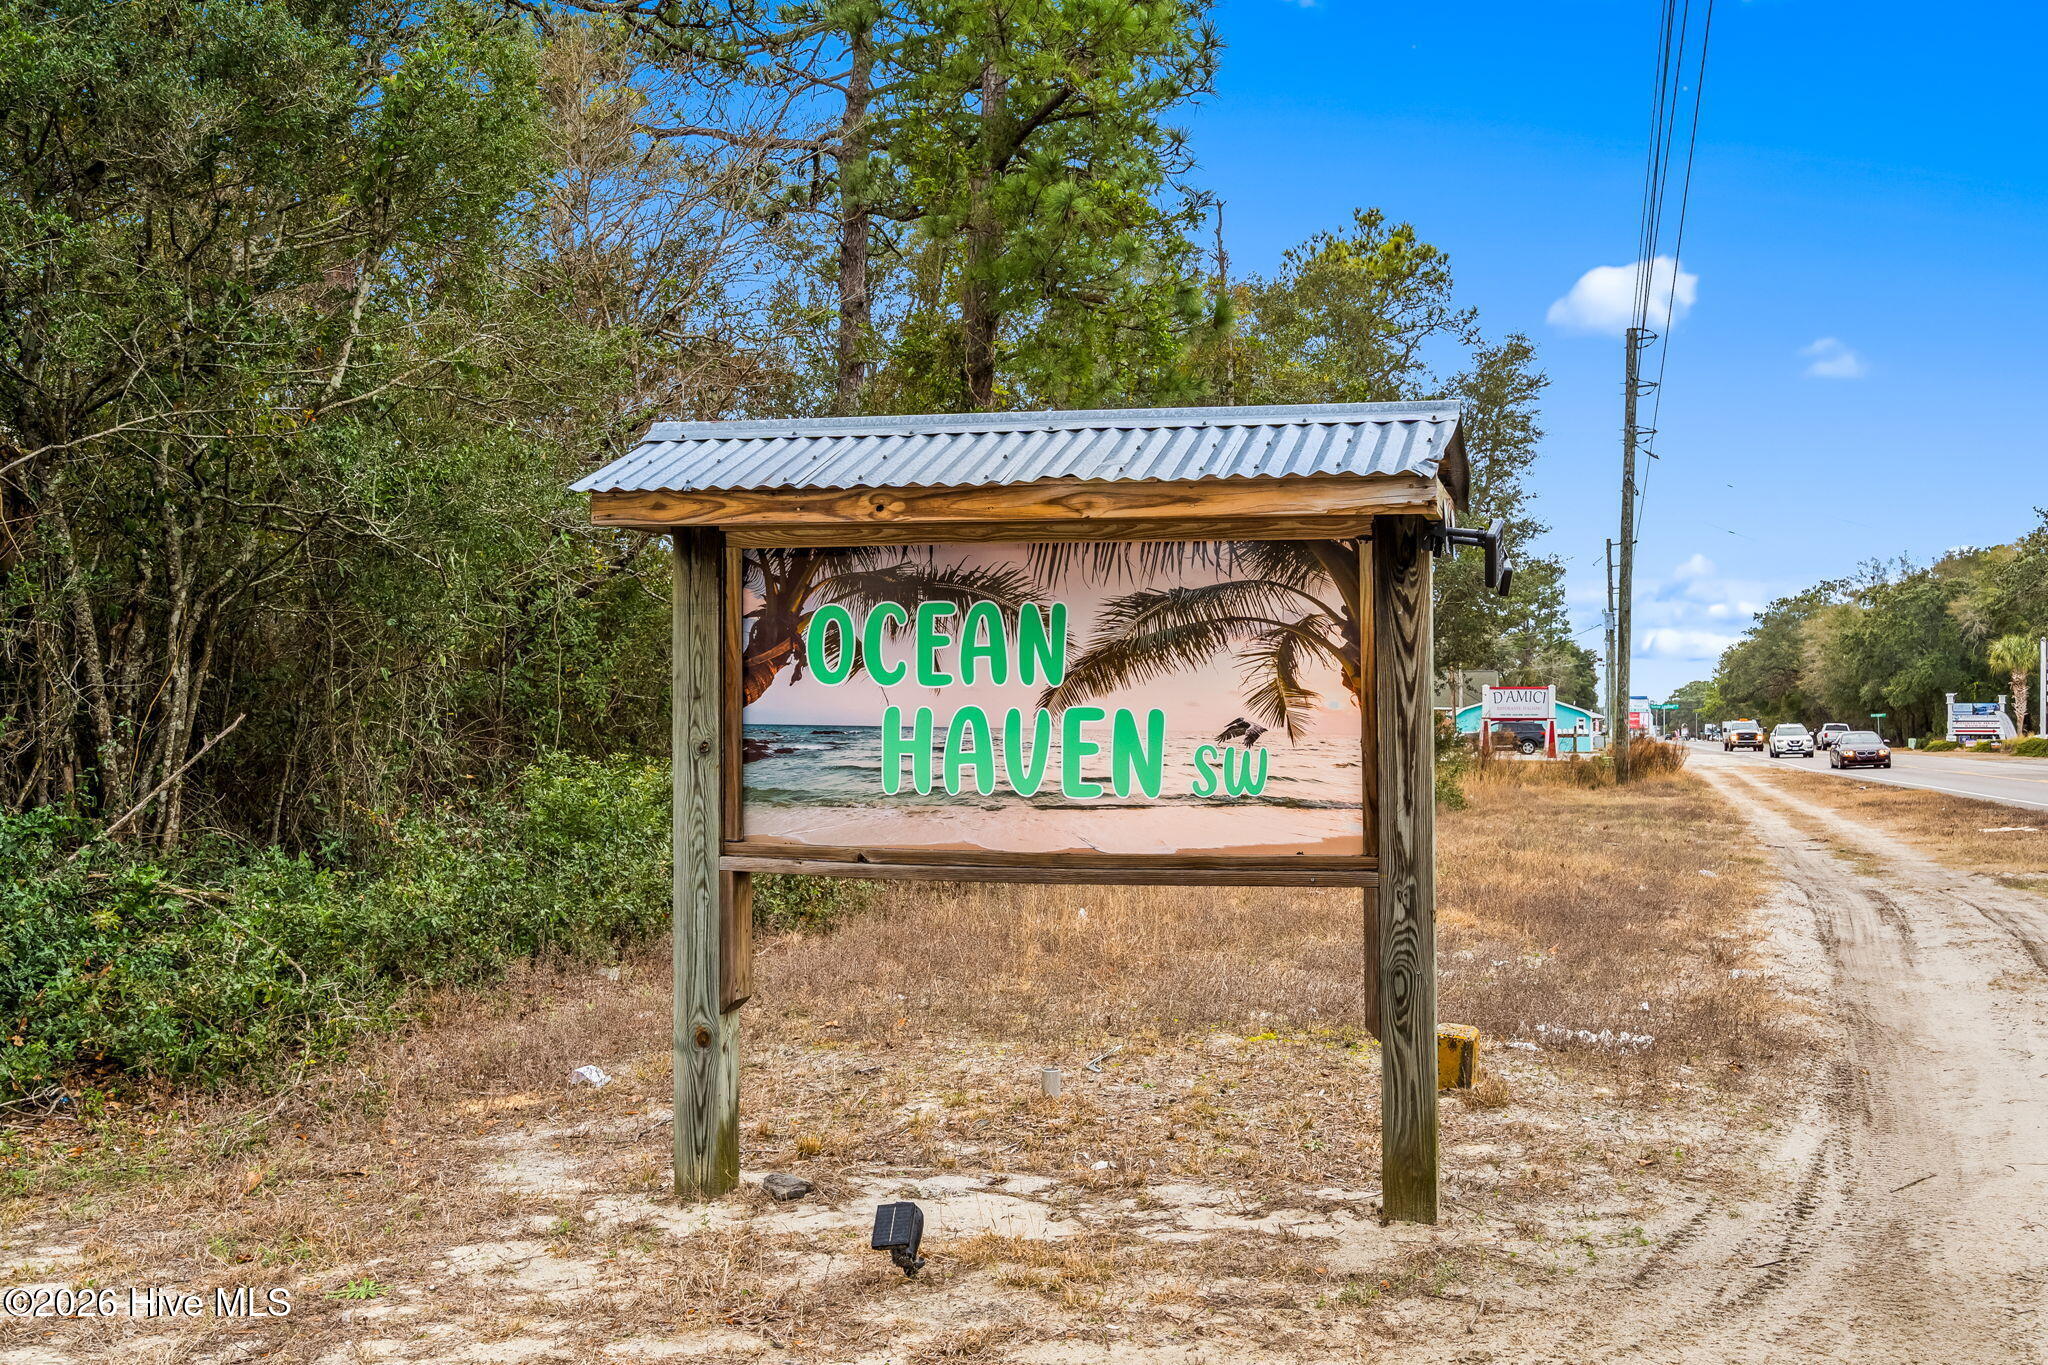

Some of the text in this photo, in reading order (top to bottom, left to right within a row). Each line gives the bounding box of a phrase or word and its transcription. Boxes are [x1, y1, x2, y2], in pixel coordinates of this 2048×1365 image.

[807, 601, 1067, 687] OCEAN
[1493, 690, 1547, 704] D'AMICI
[882, 705, 1268, 798] HAVEN SW
